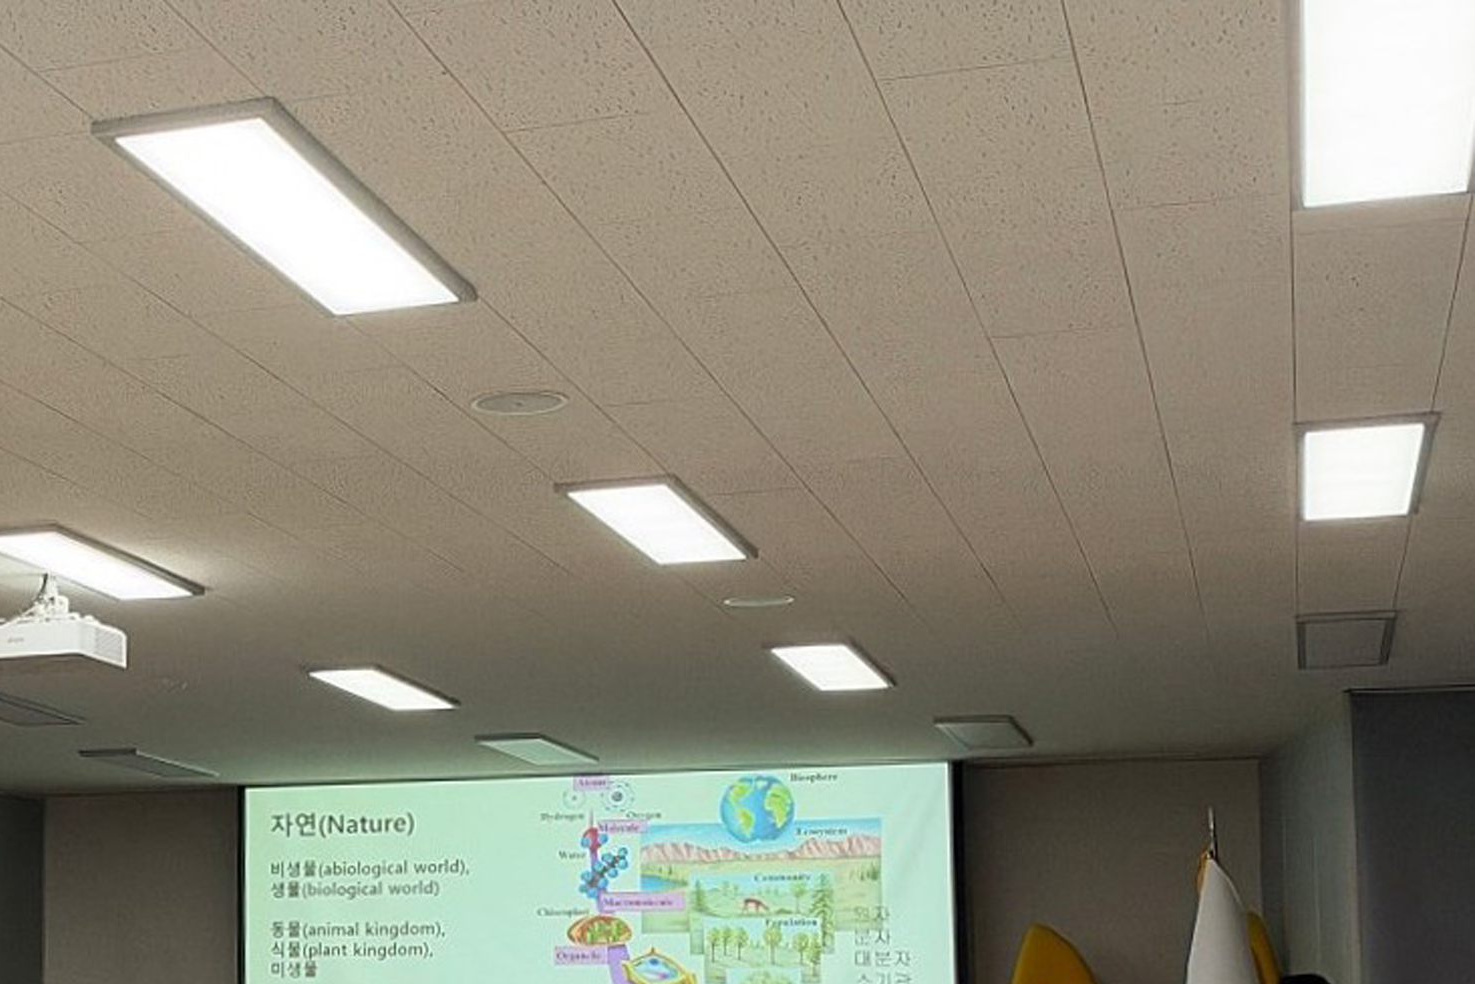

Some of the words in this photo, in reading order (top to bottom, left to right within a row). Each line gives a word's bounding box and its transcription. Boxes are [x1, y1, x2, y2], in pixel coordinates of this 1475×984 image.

[270, 811, 416, 838] 자연(Nature)
[270, 859, 408, 878] 비생물(abiological
[413, 858, 471, 876] world),
[270, 880, 383, 900] 생물(biological
[388, 879, 440, 897] world)
[270, 920, 360, 939] 동물(animal
[364, 920, 446, 940] kingdom),
[270, 941, 348, 960] 식물(plant
[352, 940, 434, 961] kingdom),
[270, 960, 318, 979] 미생물
